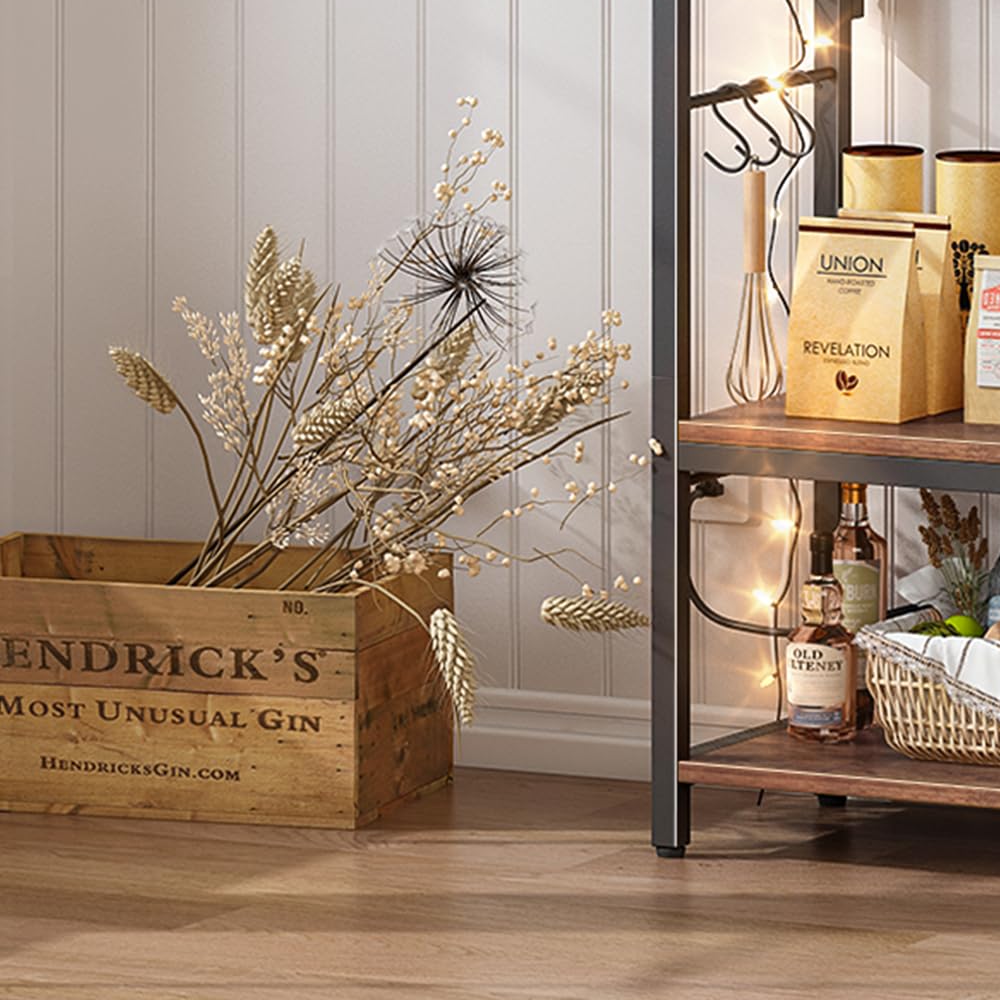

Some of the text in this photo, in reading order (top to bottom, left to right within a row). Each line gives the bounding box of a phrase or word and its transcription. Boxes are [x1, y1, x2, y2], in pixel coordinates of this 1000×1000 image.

[820, 253, 884, 273] UNION
[803, 340, 890, 359] REVELATION
[282, 600, 309, 616] NO.
[793, 647, 824, 660] OLD
[0, 695, 322, 733] MOST UNUSUAL GIN
